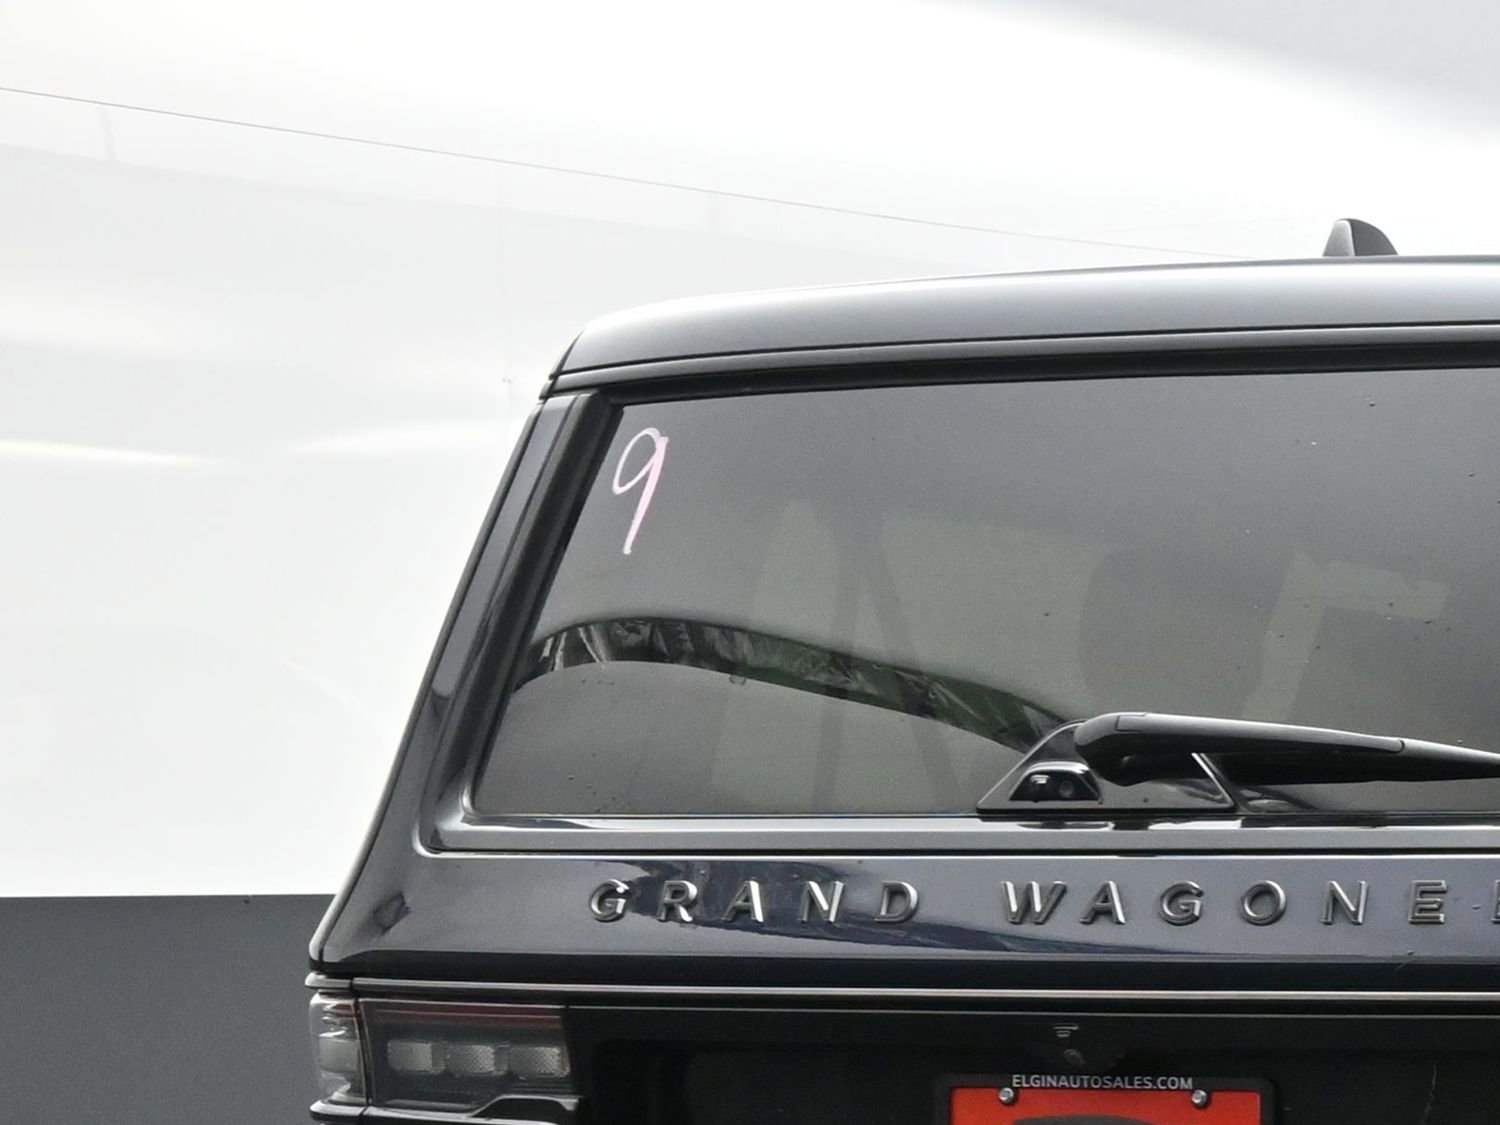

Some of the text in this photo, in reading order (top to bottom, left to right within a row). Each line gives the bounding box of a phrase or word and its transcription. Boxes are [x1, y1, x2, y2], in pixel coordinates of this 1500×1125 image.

[612, 427, 669, 555] 9
[588, 878, 919, 923] GRAND
[1012, 1074, 1193, 1090] ELGINAUTOSALES.COM
